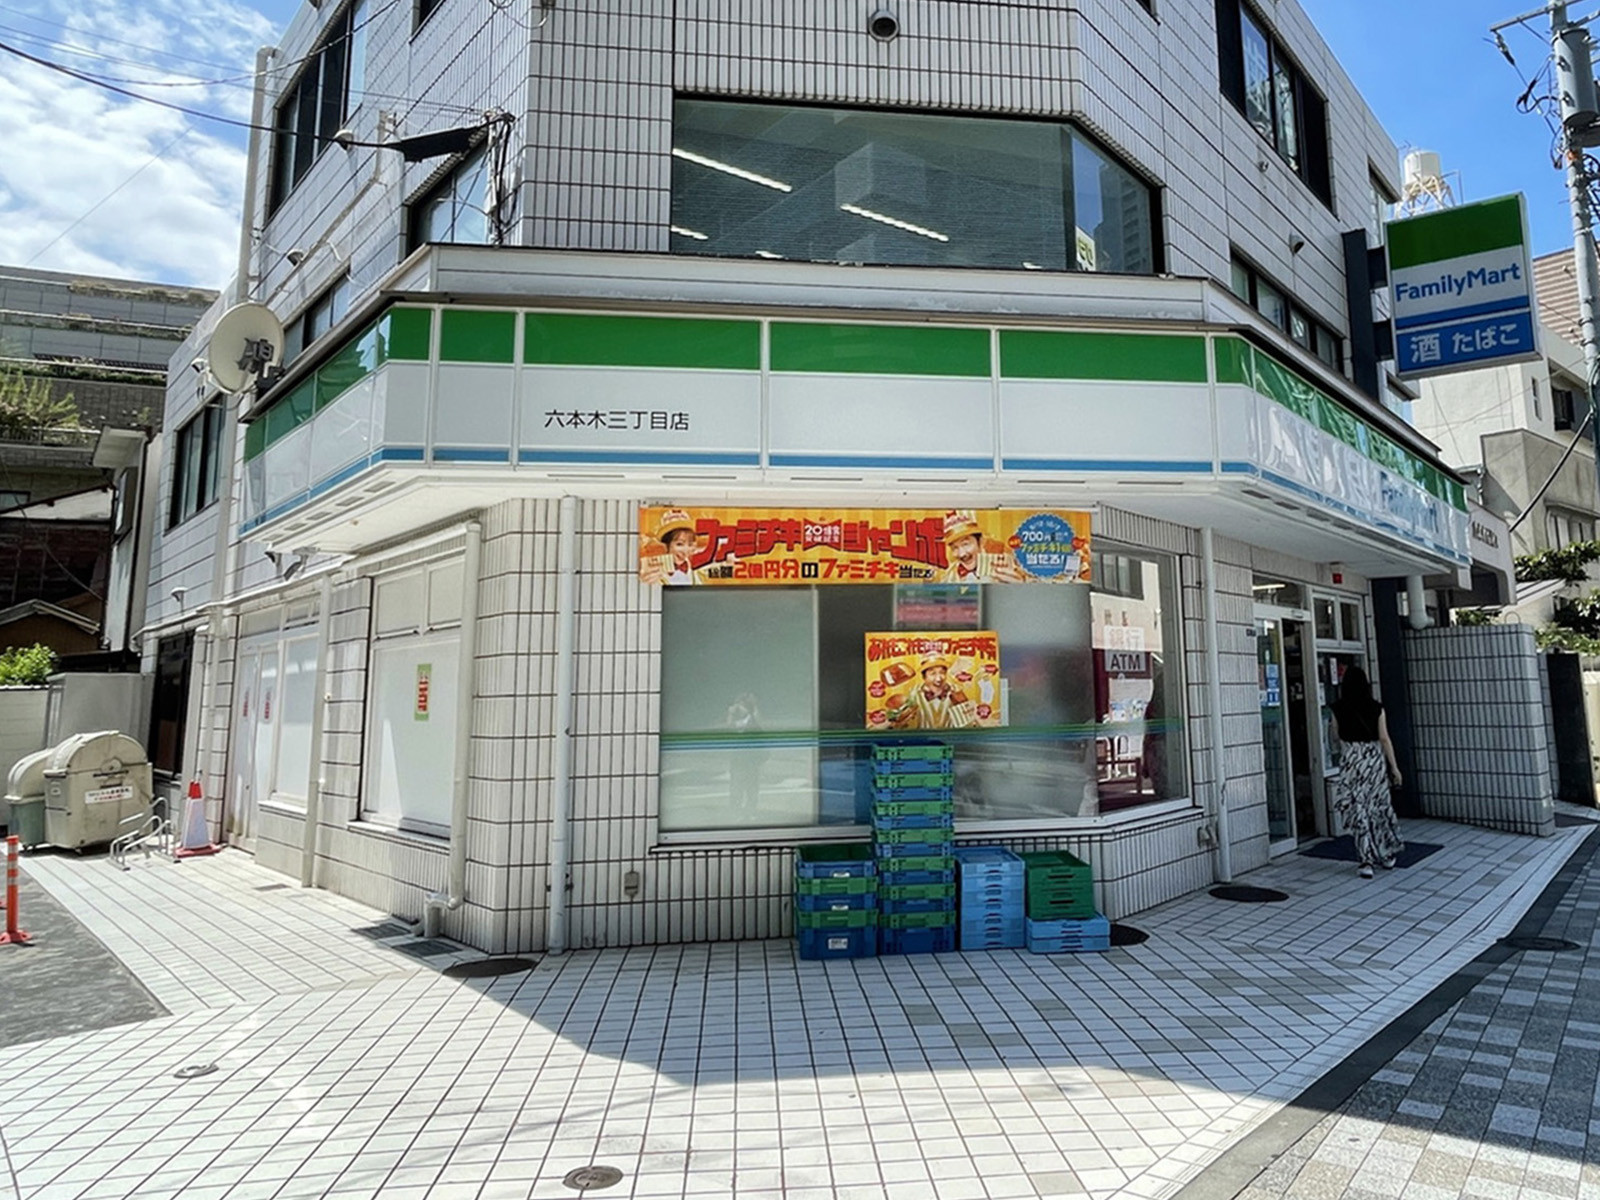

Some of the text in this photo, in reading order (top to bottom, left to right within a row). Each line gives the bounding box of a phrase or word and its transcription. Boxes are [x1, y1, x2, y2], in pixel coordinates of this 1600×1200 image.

[1395, 262, 1521, 302] FamilyMart
[1410, 323, 1520, 363] 酒 たばこ
[544, 408, 689, 431] 六本木三丁目店
[691, 518, 949, 570] ファミチキ ジャンボ
[1110, 653, 1141, 670] ATM
